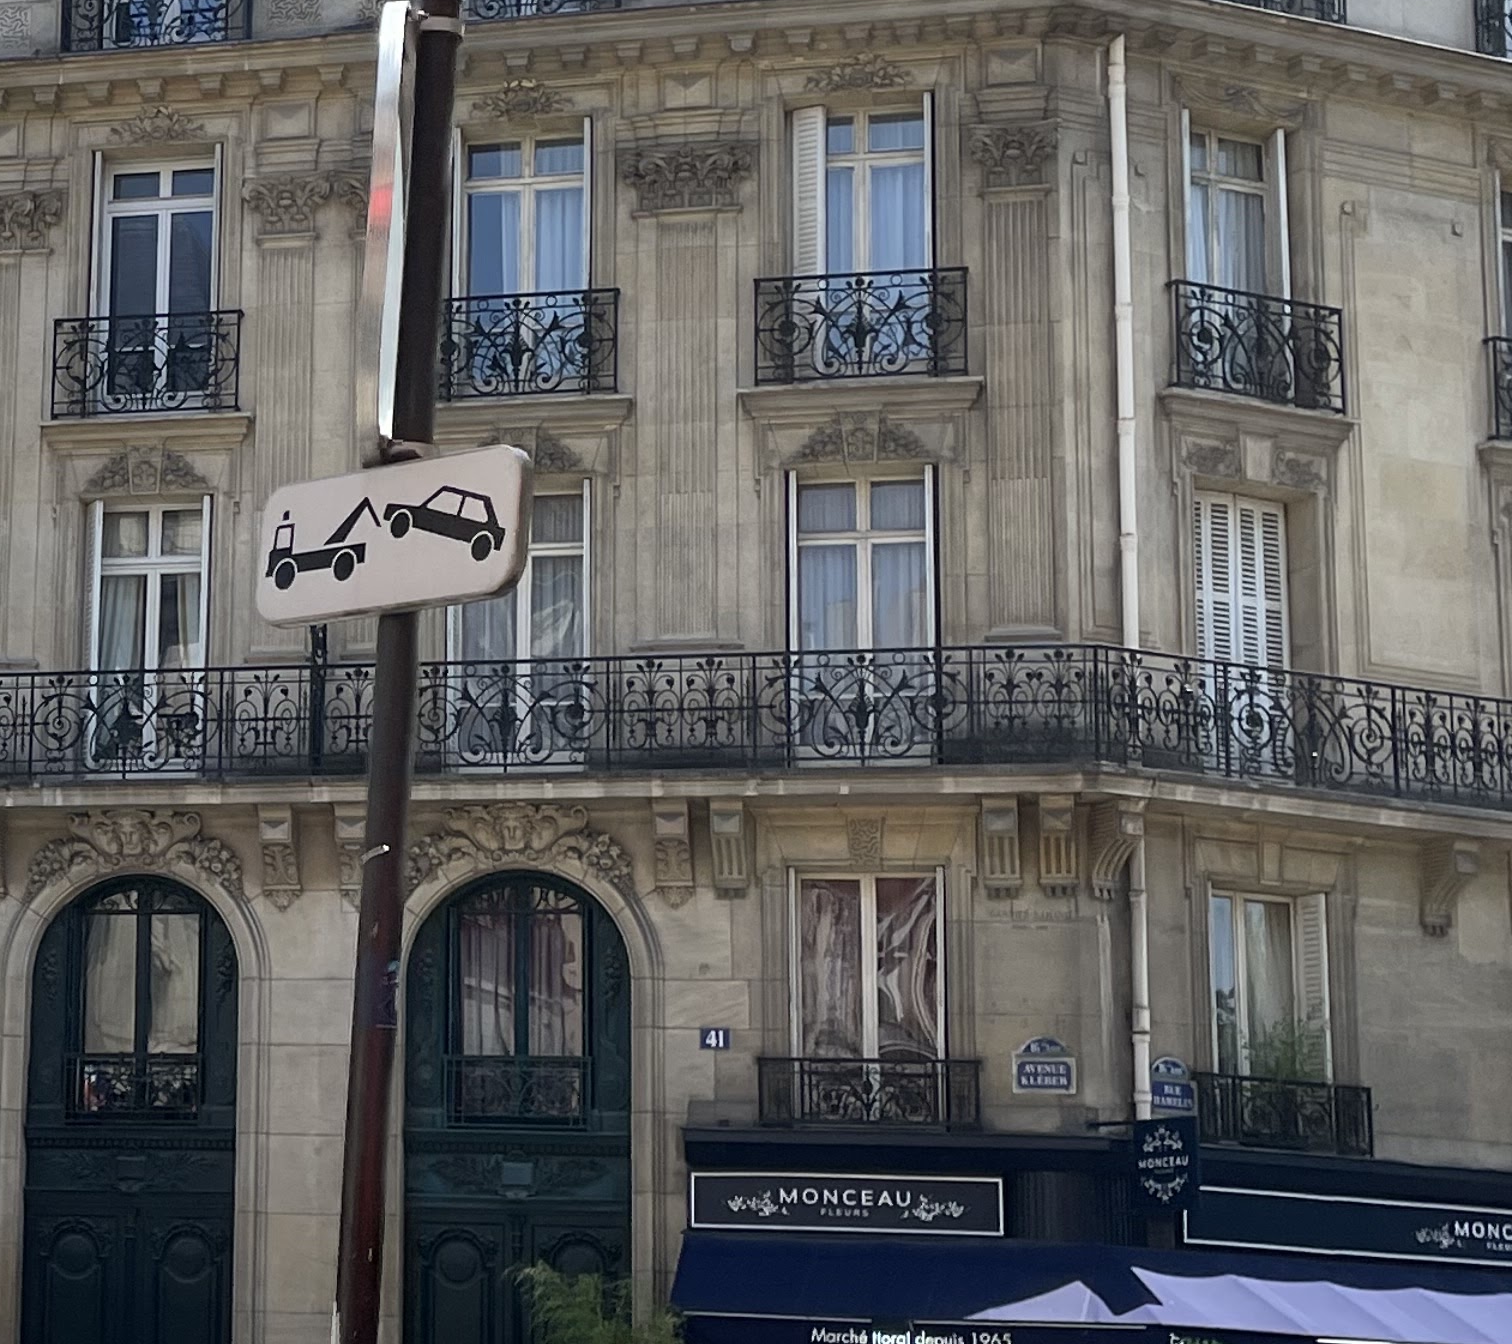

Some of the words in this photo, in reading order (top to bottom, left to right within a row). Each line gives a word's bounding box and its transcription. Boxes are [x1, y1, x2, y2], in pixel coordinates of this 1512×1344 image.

[705, 1030, 724, 1047] 41
[1023, 1064, 1067, 1074] AVENUE
[1137, 1155, 1189, 1170] MONCEAU
[779, 1187, 911, 1207] MONCEAU
[820, 1207, 869, 1217] FLEURS
[811, 1327, 868, 1344] Marché
